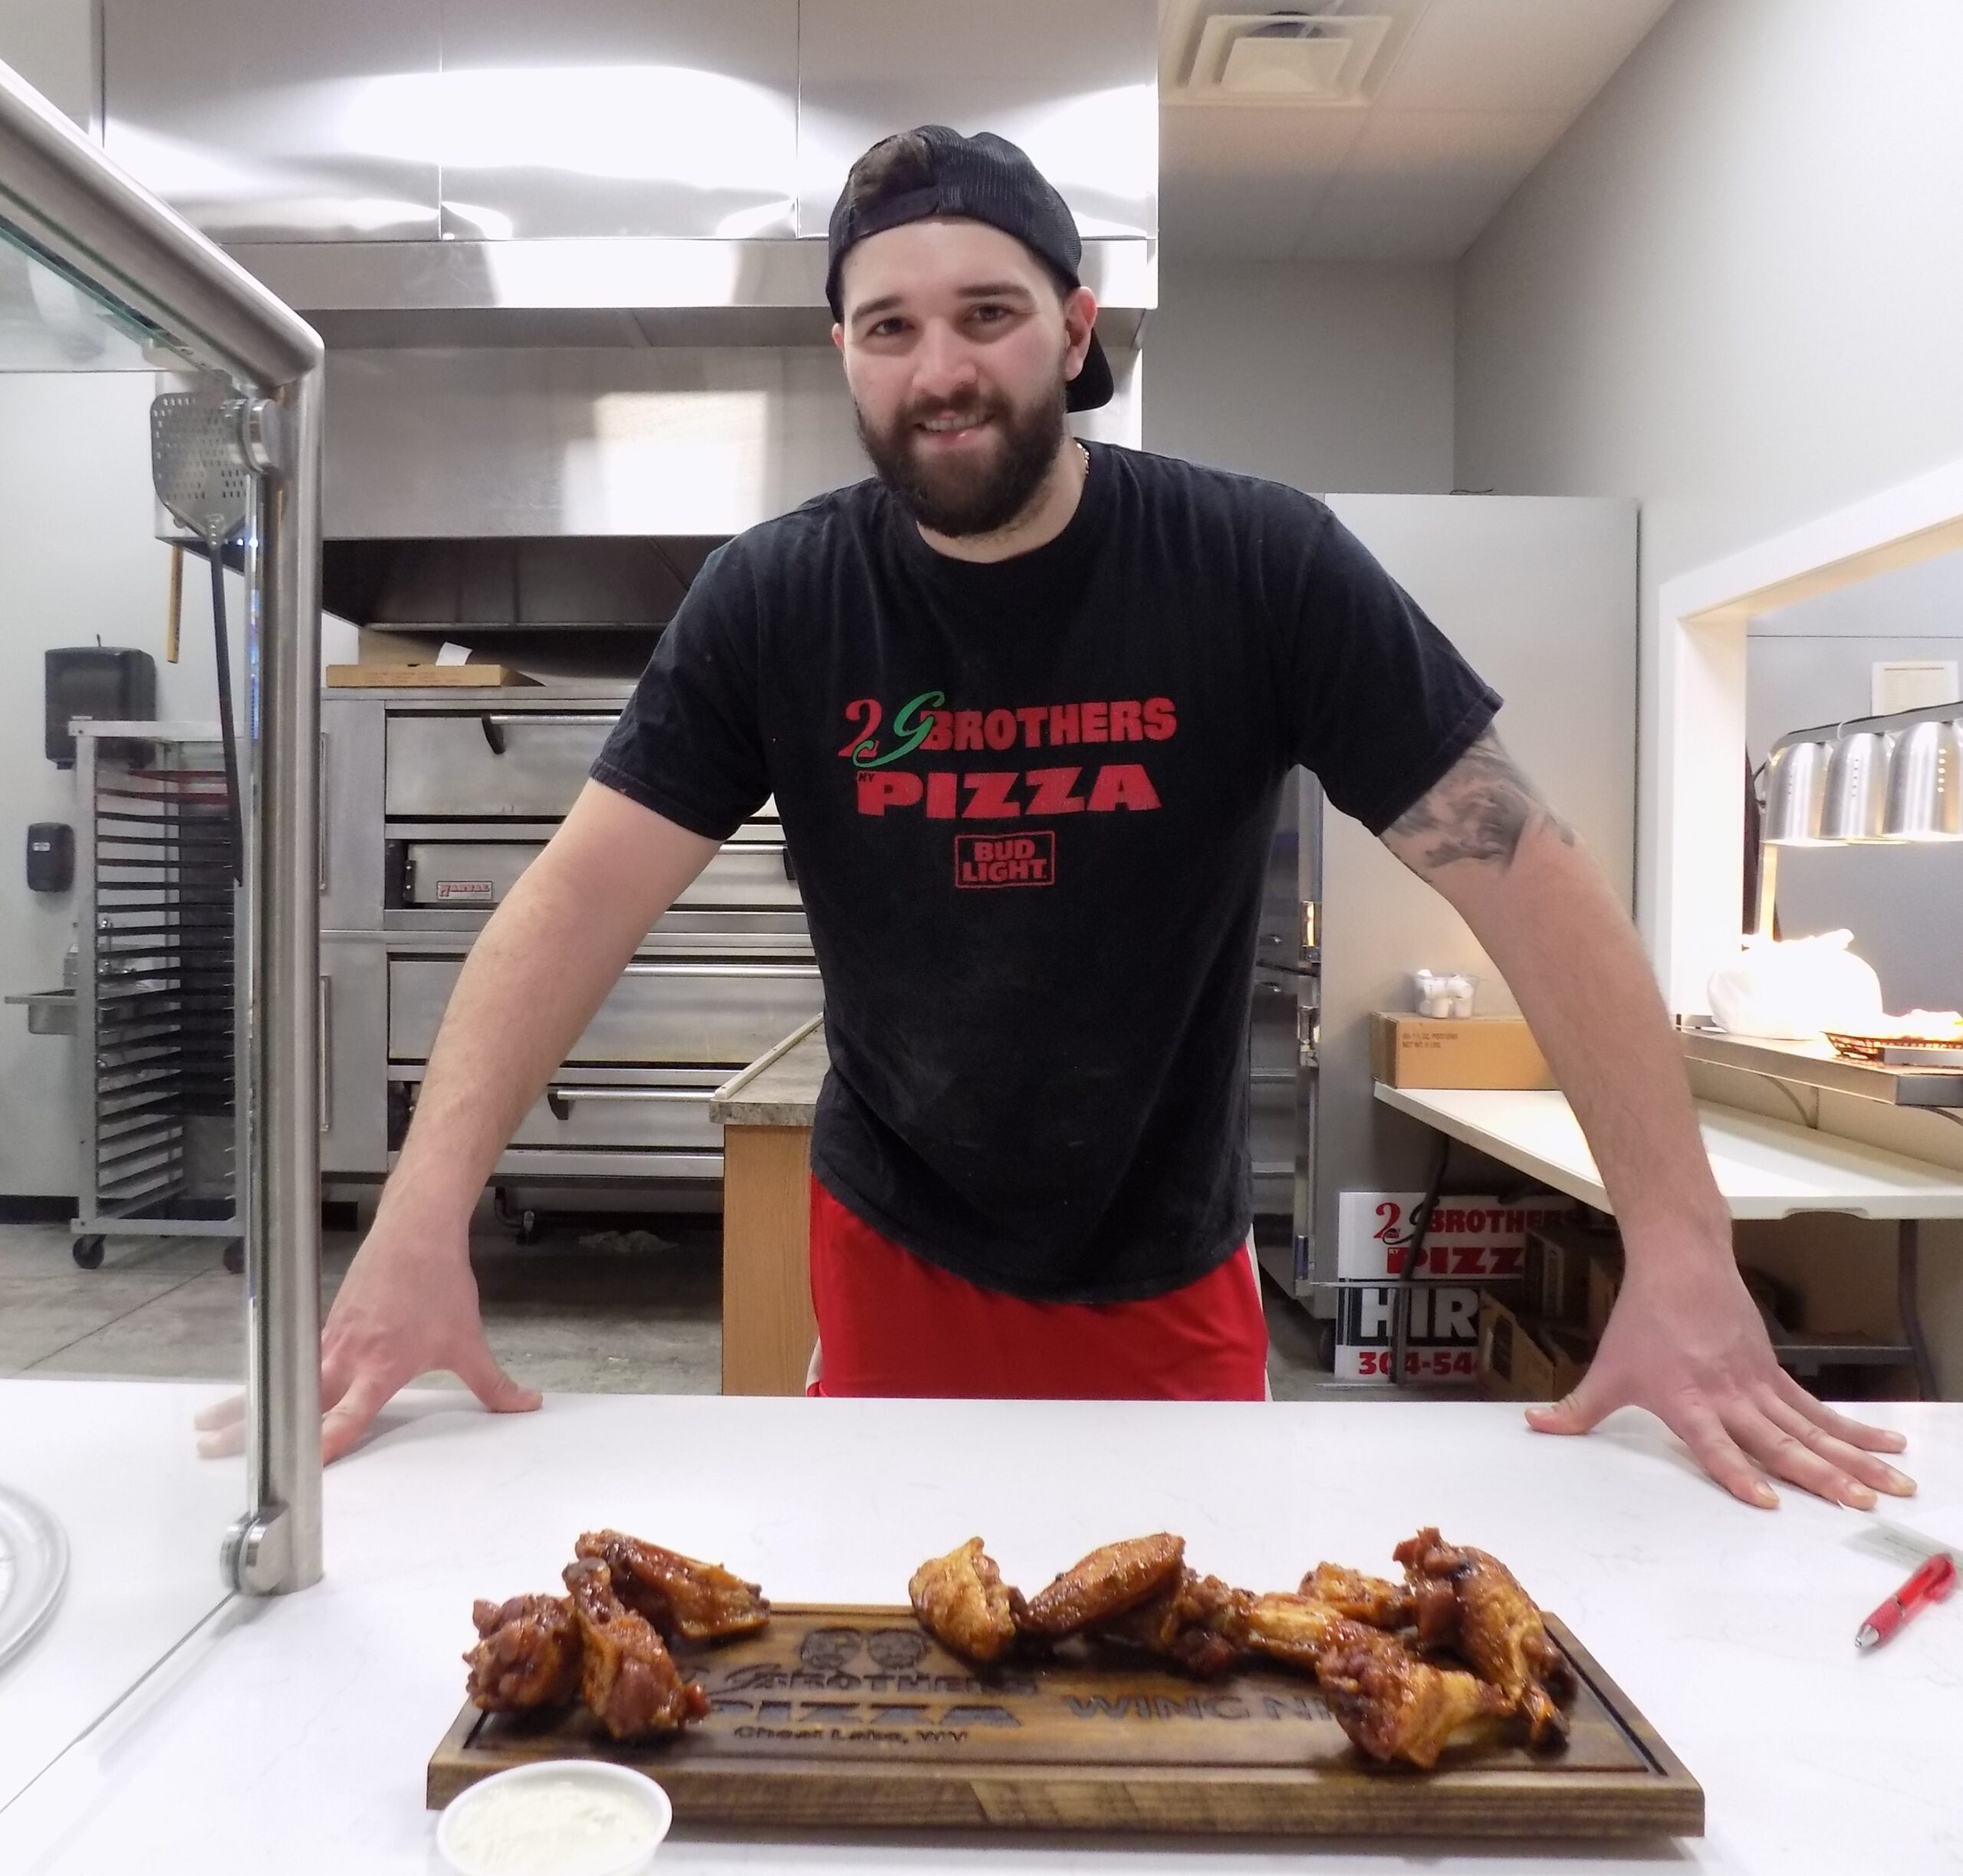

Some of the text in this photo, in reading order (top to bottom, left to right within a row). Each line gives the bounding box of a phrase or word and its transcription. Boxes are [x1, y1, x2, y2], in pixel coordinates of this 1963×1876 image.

[838, 698, 883, 757] 2
[919, 697, 1178, 751] BROTHERS
[858, 772, 875, 782] NY
[857, 764, 1162, 819] PIZZA
[974, 839, 1034, 861] BUD
[962, 858, 1048, 882] LIGHT
[1373, 1202, 1401, 1239] 2
[1387, 1247, 1524, 1274] PIZZ
[1360, 1288, 1479, 1338] HIR
[1359, 1352, 1480, 1375] 304-54
[1061, 1694, 1250, 1720] WING
